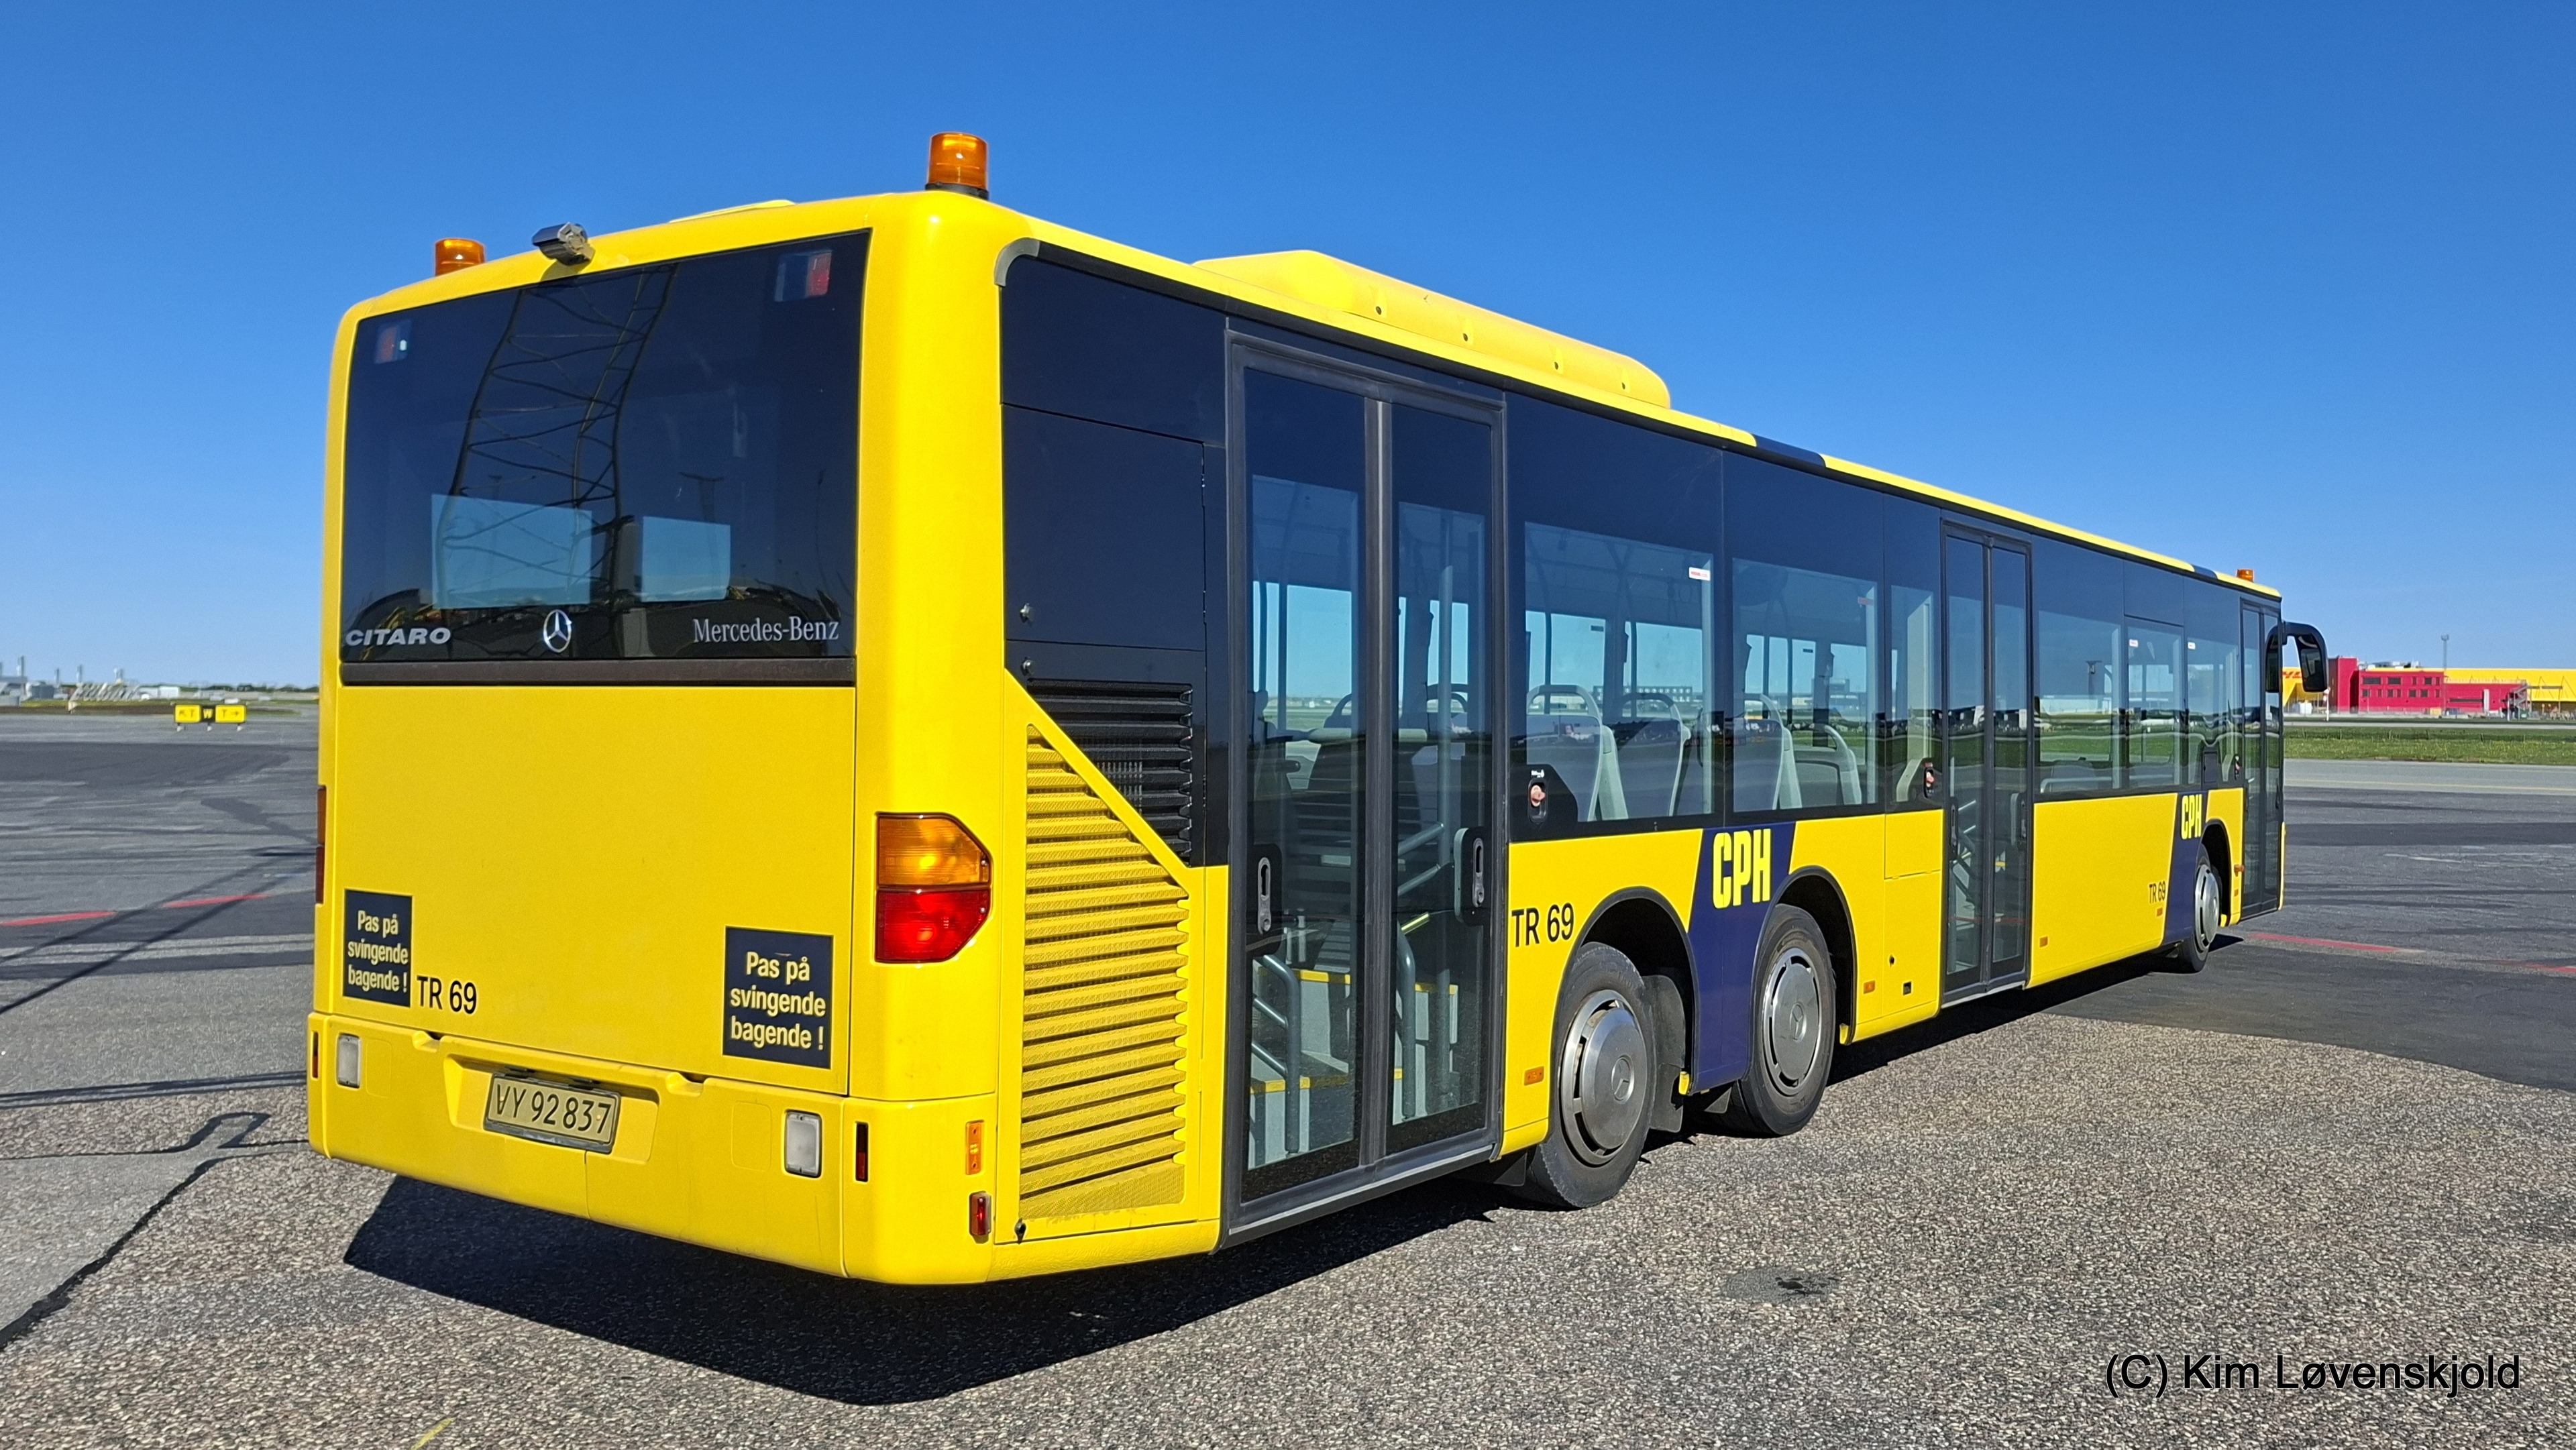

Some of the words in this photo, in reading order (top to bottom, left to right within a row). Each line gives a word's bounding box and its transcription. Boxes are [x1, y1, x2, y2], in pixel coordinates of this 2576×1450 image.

[345, 627, 451, 646] CITARO
[693, 616, 839, 643] Mercedes-Benz
[203, 708, 213, 719] W
[2182, 794, 2202, 840] CPH
[1713, 828, 1771, 909] CPH
[2149, 883, 2157, 904] TR
[2158, 881, 2166, 902] 69
[358, 910, 379, 933] Pas
[382, 913, 398, 938] på
[1511, 907, 1540, 947] TR
[1547, 903, 1574, 942] 69
[347, 938, 409, 965] svingende
[348, 964, 400, 992] bagende
[746, 951, 780, 979] Pas
[786, 956, 810, 985] på
[417, 974, 443, 1010] TR
[449, 980, 477, 1015] 69
[730, 985, 826, 1017] svingende
[731, 1015, 812, 1048] bagende
[496, 1083, 527, 1119] VY
